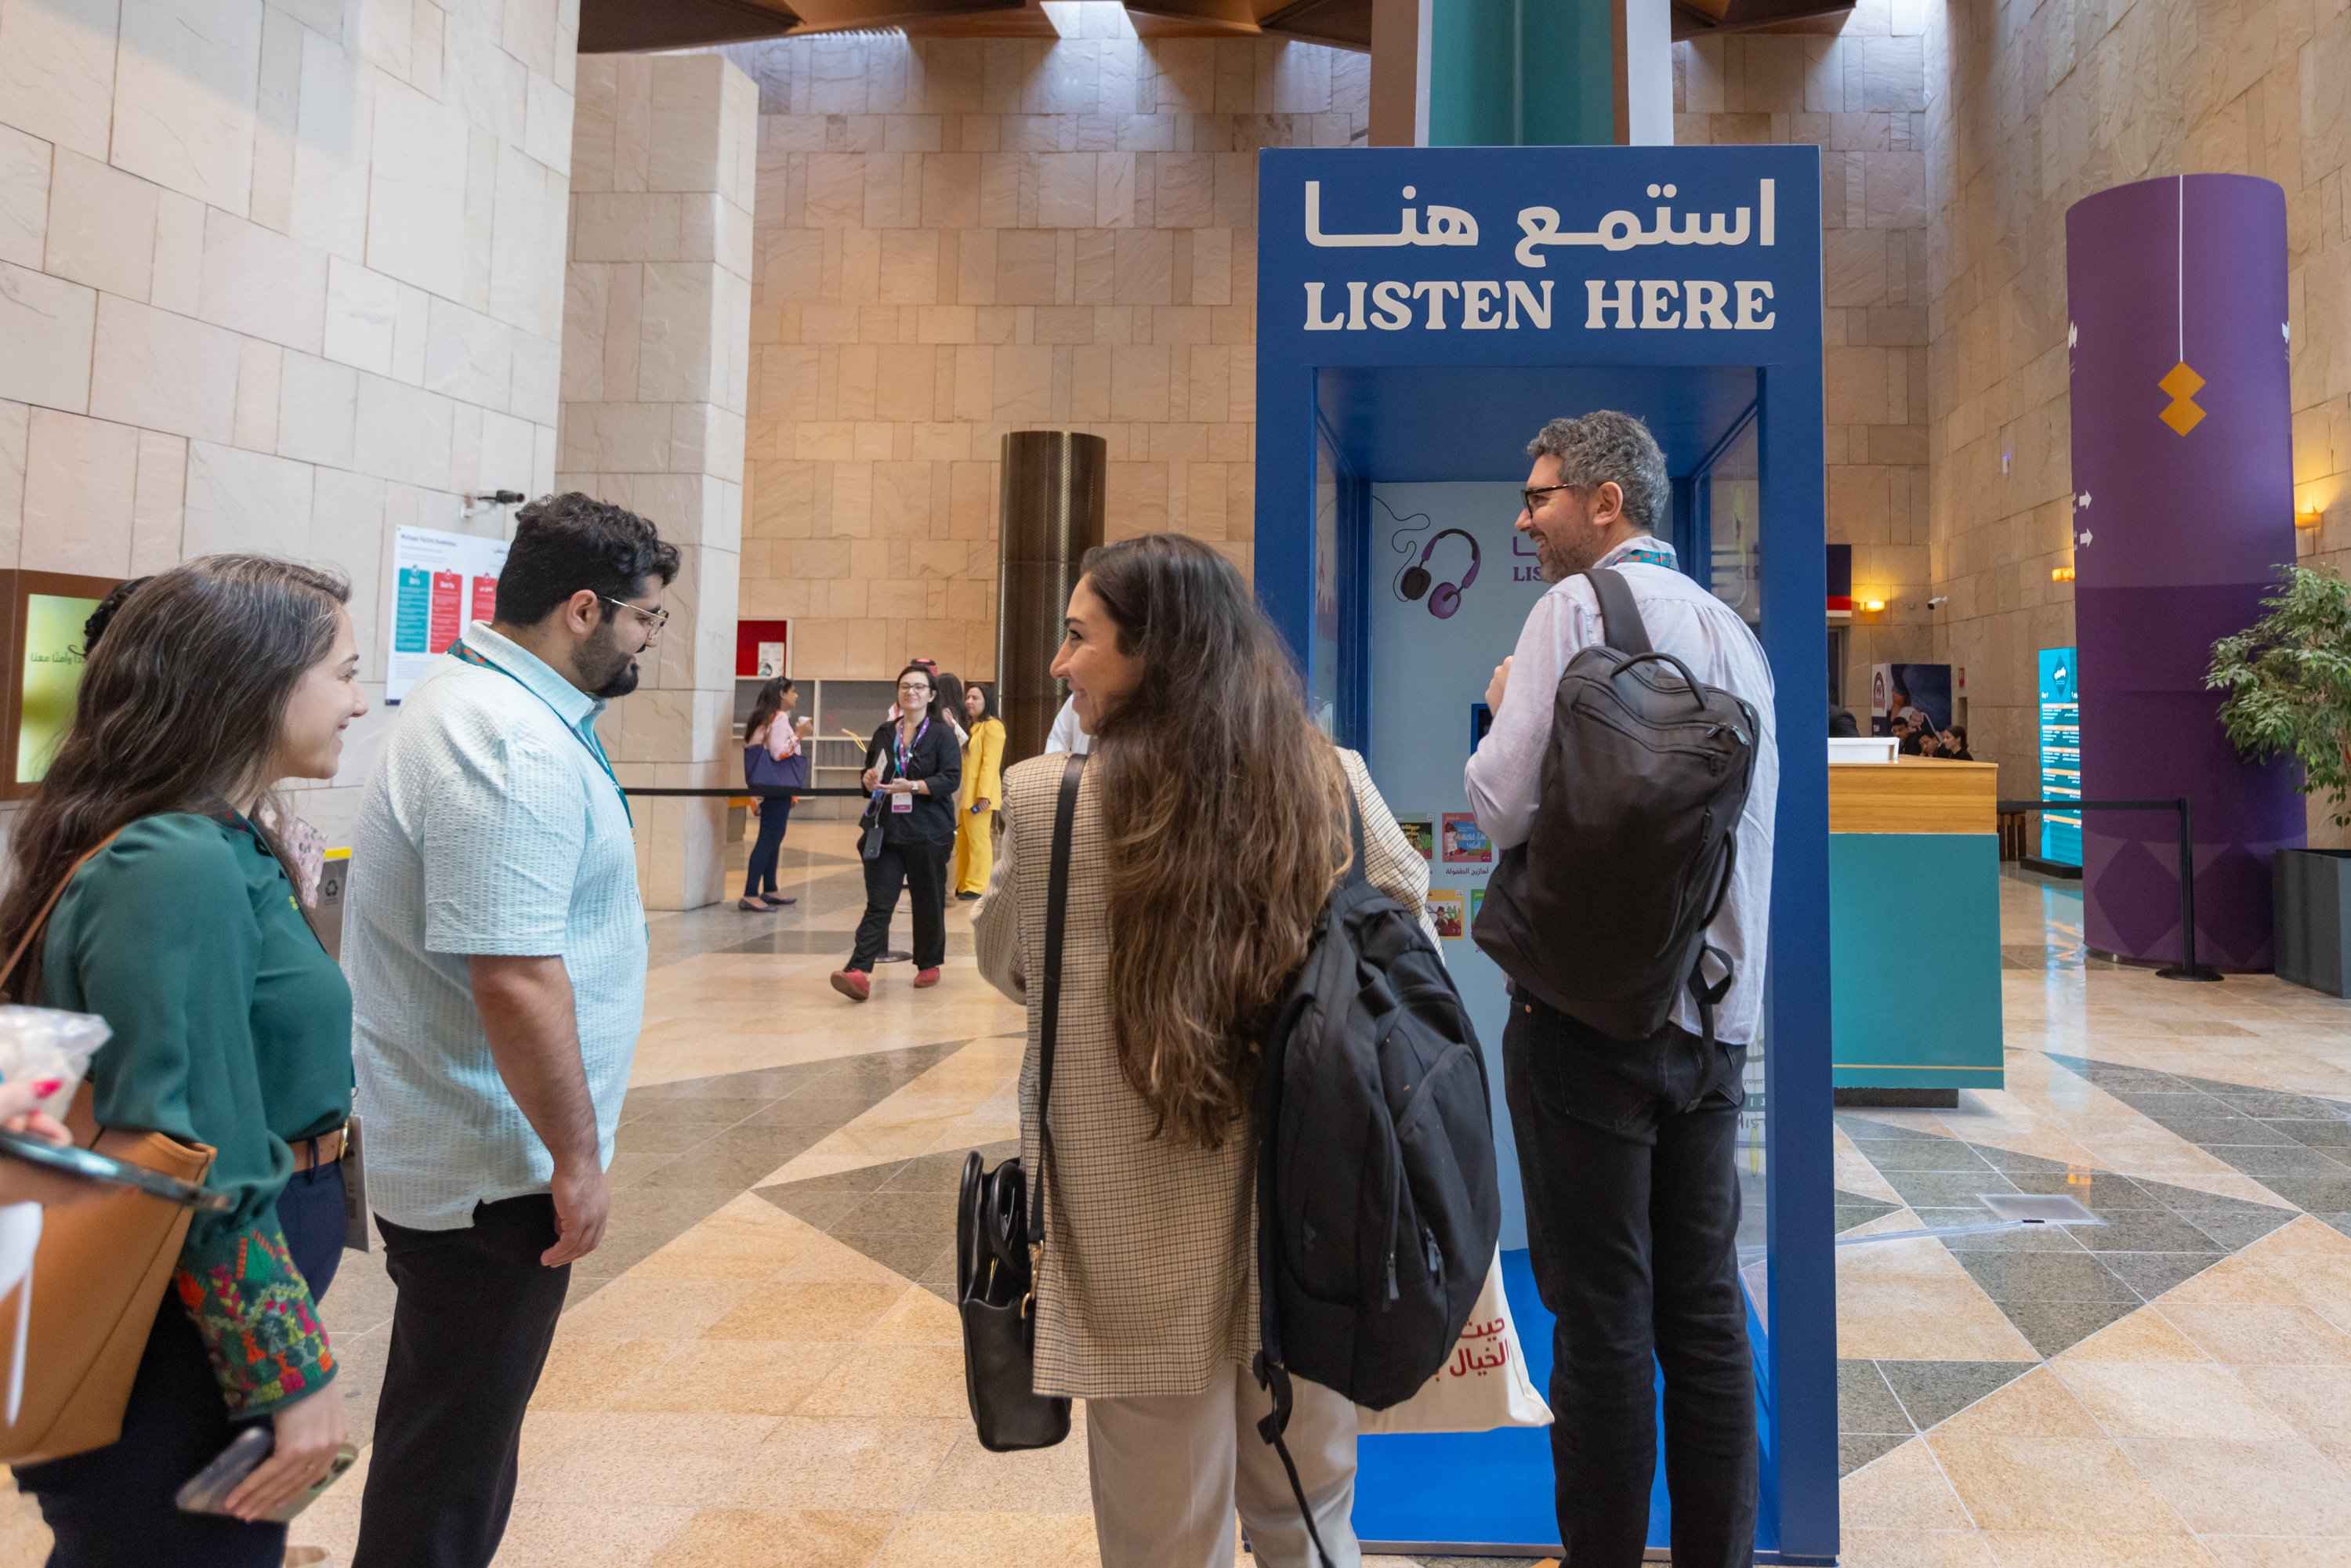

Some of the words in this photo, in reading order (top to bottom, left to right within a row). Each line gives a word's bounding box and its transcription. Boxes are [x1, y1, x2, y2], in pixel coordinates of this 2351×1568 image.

[1306, 181, 1479, 247] هنا
[1515, 179, 1774, 267] استمع
[1304, 281, 1554, 330] LISTEN
[1585, 281, 1775, 329] HERE
[1513, 567, 1543, 581] LIS
[1450, 1338, 1509, 1377] الخيال
